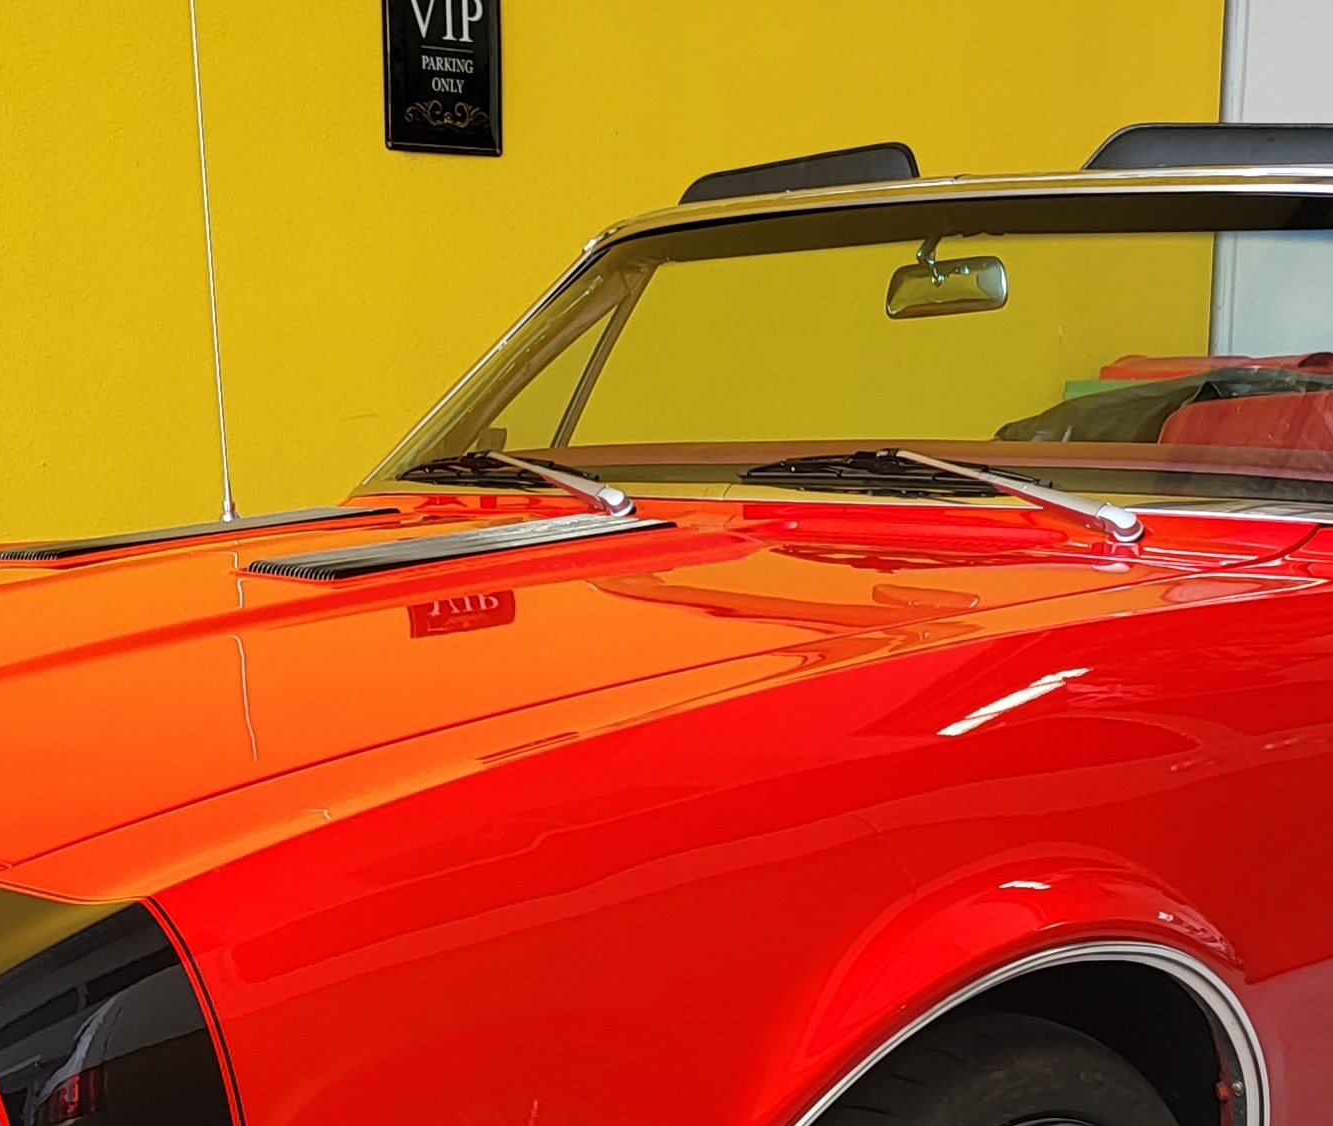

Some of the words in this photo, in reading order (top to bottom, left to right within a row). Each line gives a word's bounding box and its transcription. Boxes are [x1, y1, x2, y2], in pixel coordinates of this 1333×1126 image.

[410, 0, 484, 43] VIP
[421, 55, 474, 74] PARKING
[431, 77, 465, 94] ONLY
